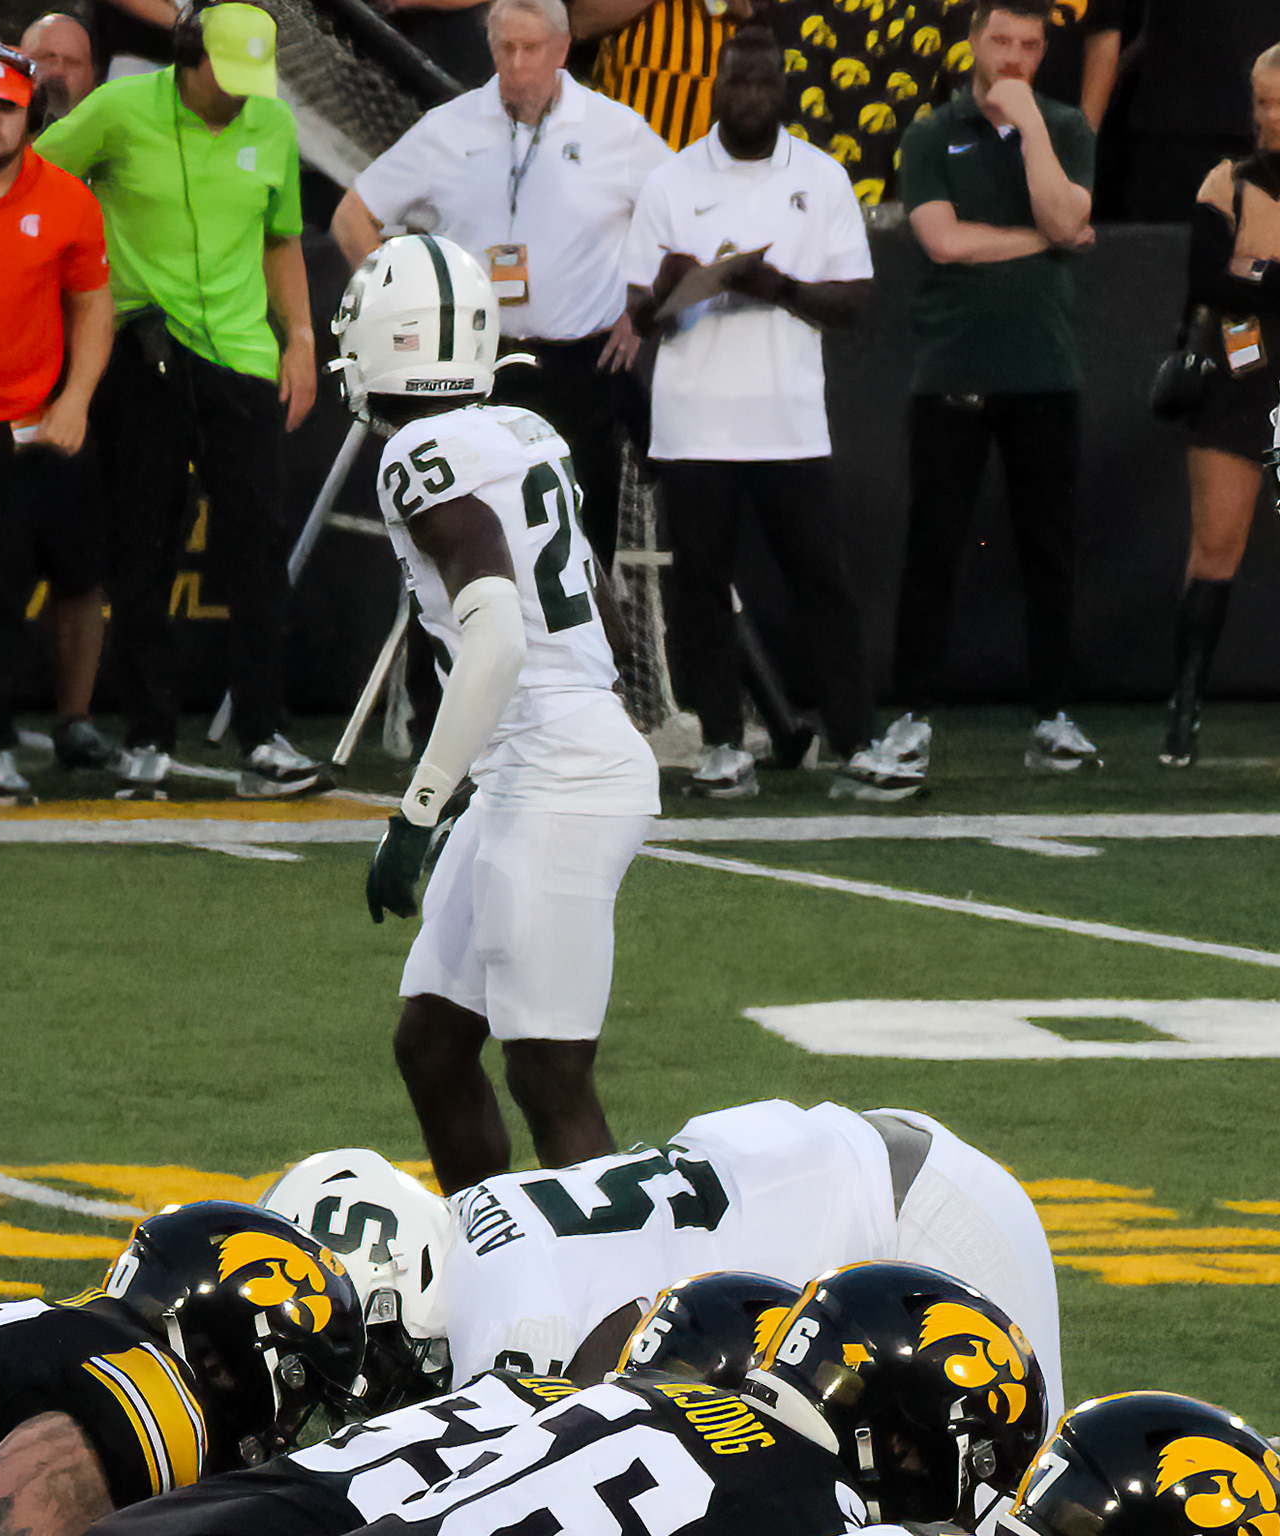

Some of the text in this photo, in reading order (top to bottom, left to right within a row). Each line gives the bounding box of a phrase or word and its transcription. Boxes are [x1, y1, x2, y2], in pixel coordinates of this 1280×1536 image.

[383, 438, 456, 519] 25
[521, 455, 597, 634] 2
[775, 1316, 820, 1367] 6
